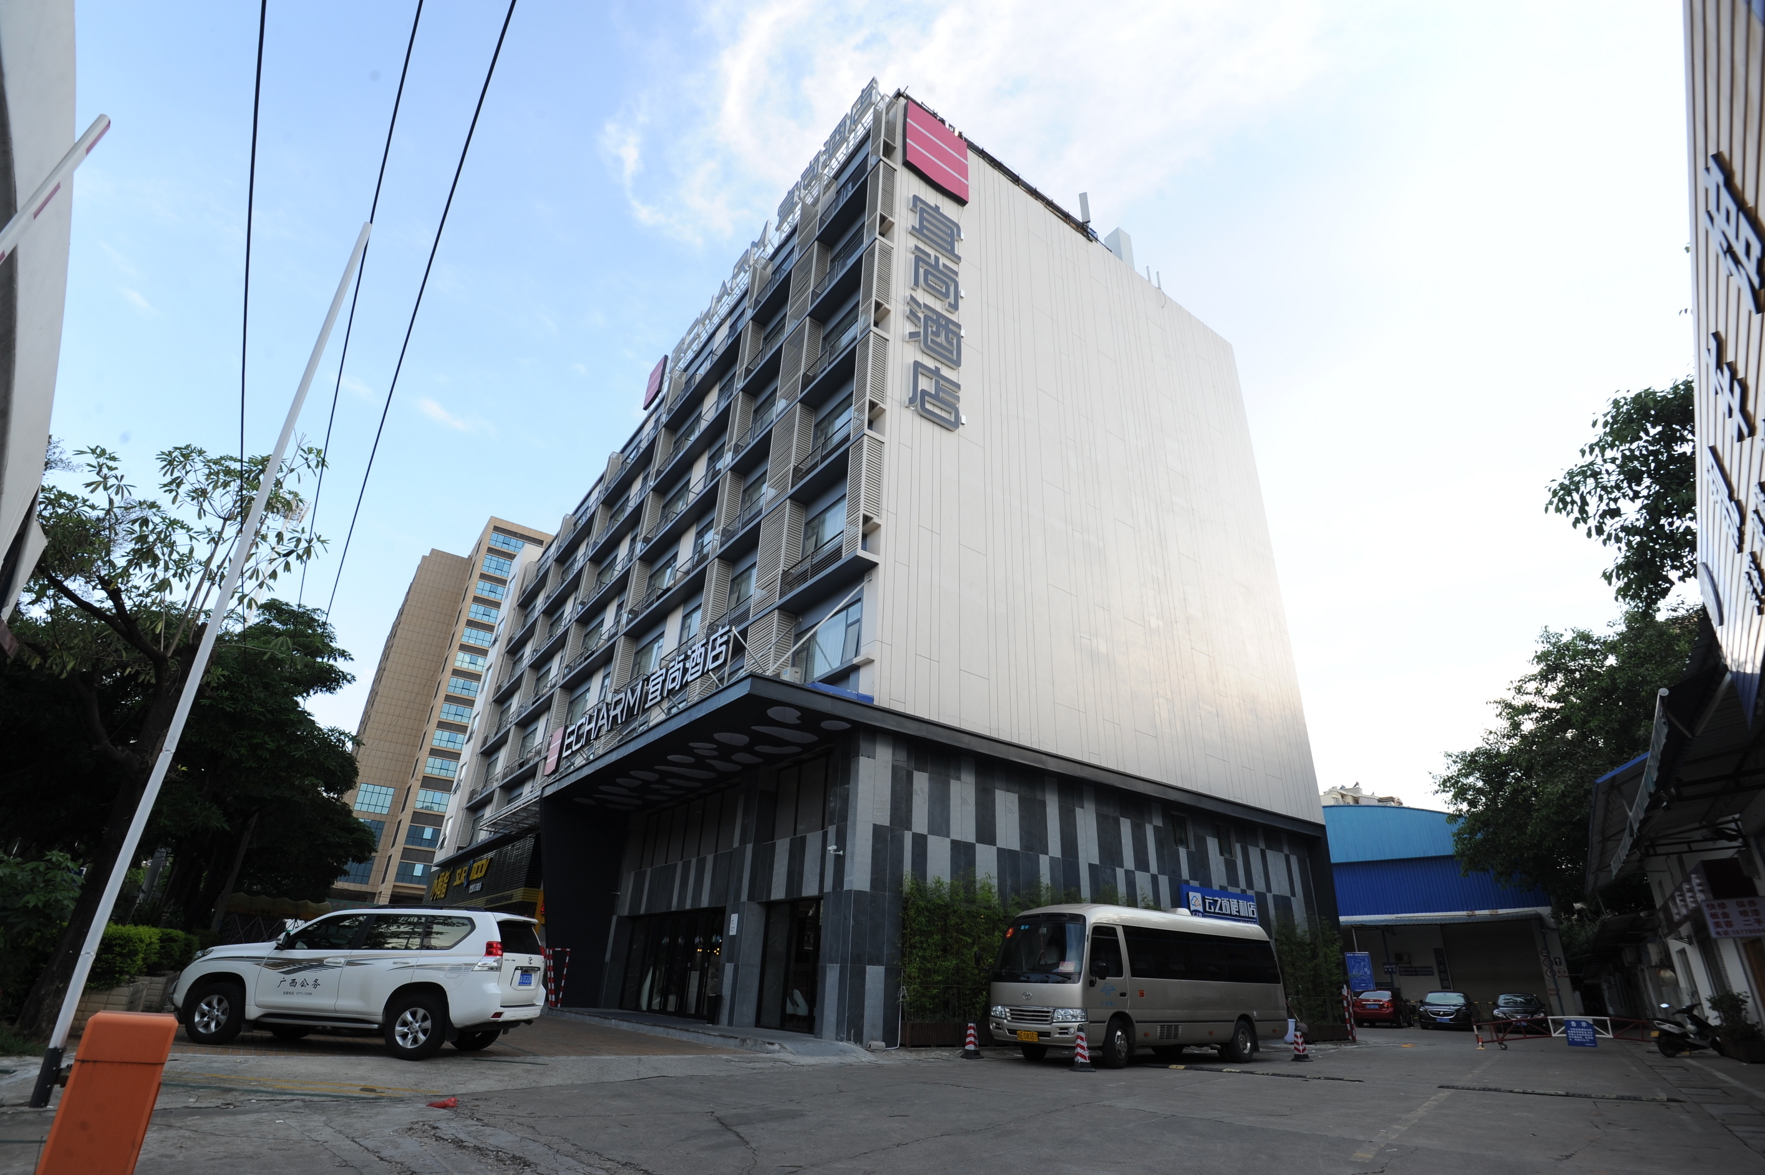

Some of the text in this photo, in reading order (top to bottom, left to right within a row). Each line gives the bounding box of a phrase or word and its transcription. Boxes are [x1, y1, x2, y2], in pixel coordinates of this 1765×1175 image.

[907, 194, 963, 432] 宜尚酒店
[562, 625, 732, 758] ECHARM 宜尚酒店
[1204, 896, 1257, 918] 云之尚便利店
[1706, 901, 1728, 911] 快修
[1709, 911, 1731, 919] 板金
[1713, 918, 1765, 929] 美容 二手
[276, 976, 321, 990] 广西公务
